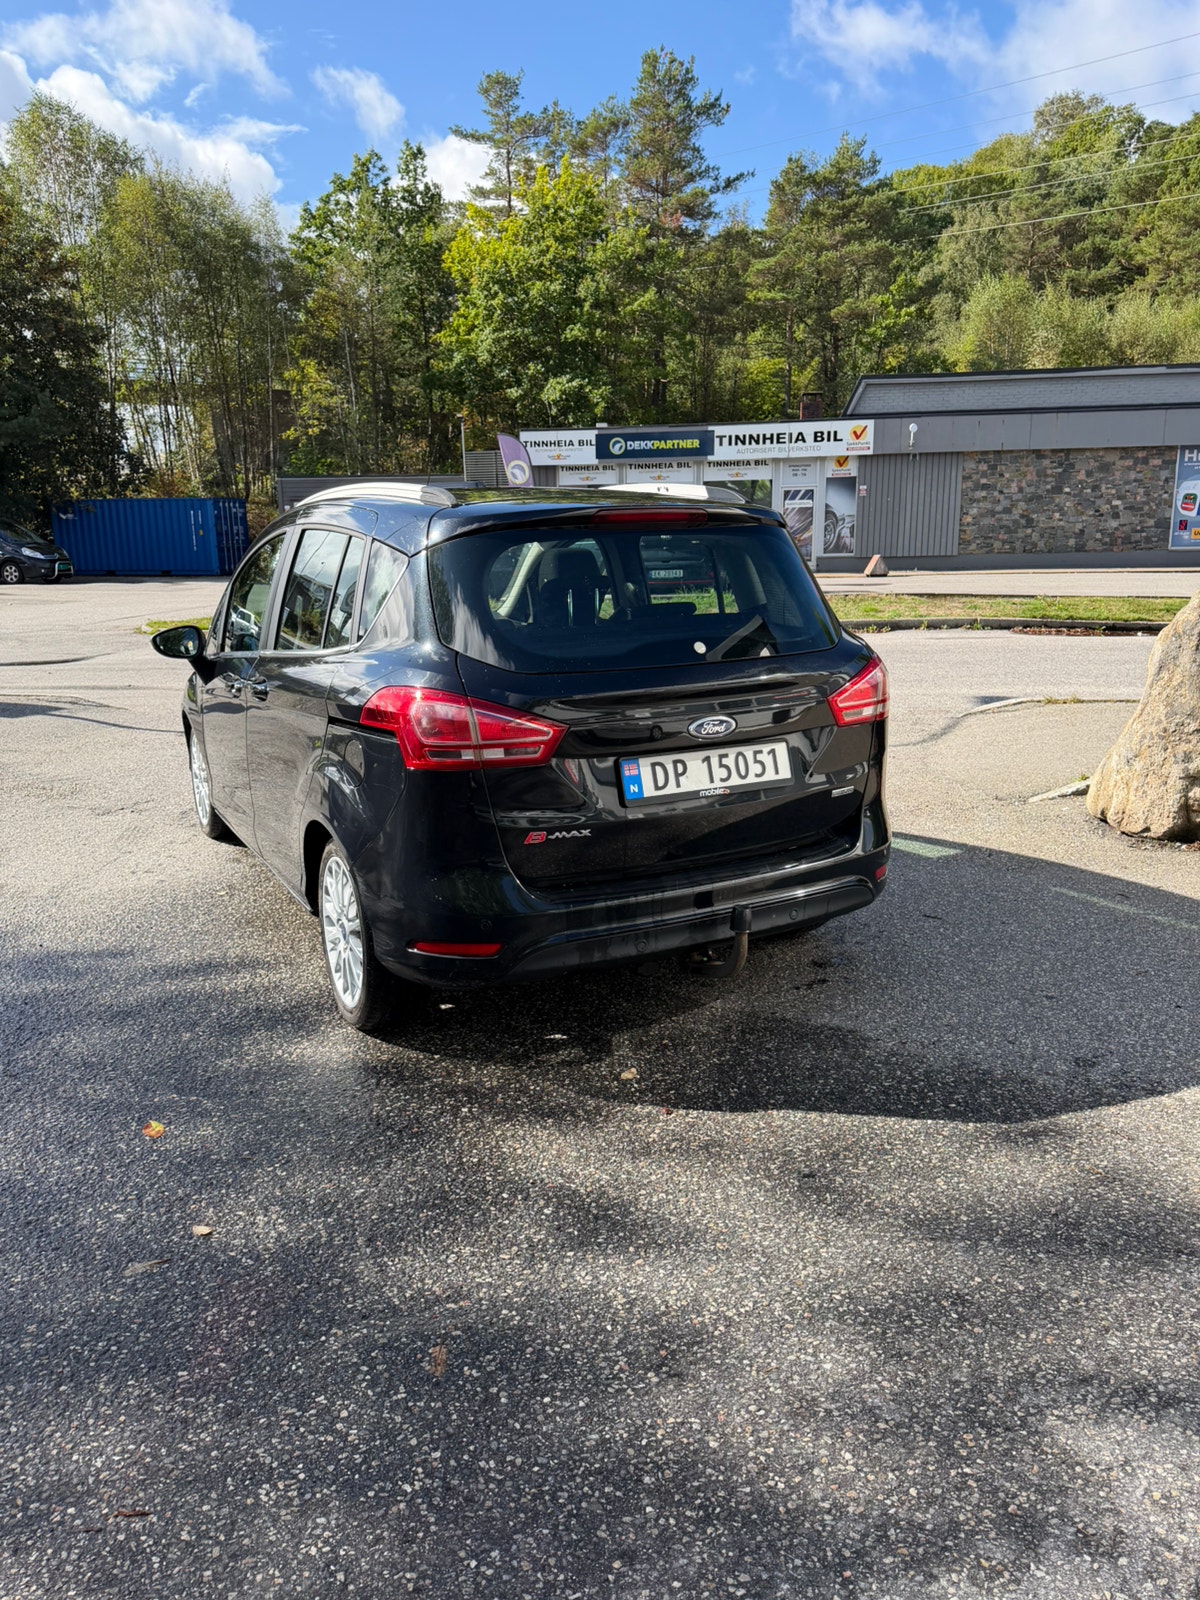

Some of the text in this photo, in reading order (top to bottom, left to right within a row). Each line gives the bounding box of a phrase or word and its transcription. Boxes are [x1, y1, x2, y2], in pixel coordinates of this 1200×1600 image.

[523, 439, 595, 448] TINNHEIA BIL
[715, 430, 844, 446] TINNHEIA BIL
[627, 439, 700, 450] DEKKPARTNER
[736, 447, 776, 455] AUTORISERT
[628, 461, 692, 470] TINNHEIA BIL
[706, 460, 752, 468] TINNHEIA
[701, 720, 727, 734] Ford
[650, 748, 780, 791] DP 15051
[629, 783, 639, 794] N
[524, 829, 592, 844] B-MAX
